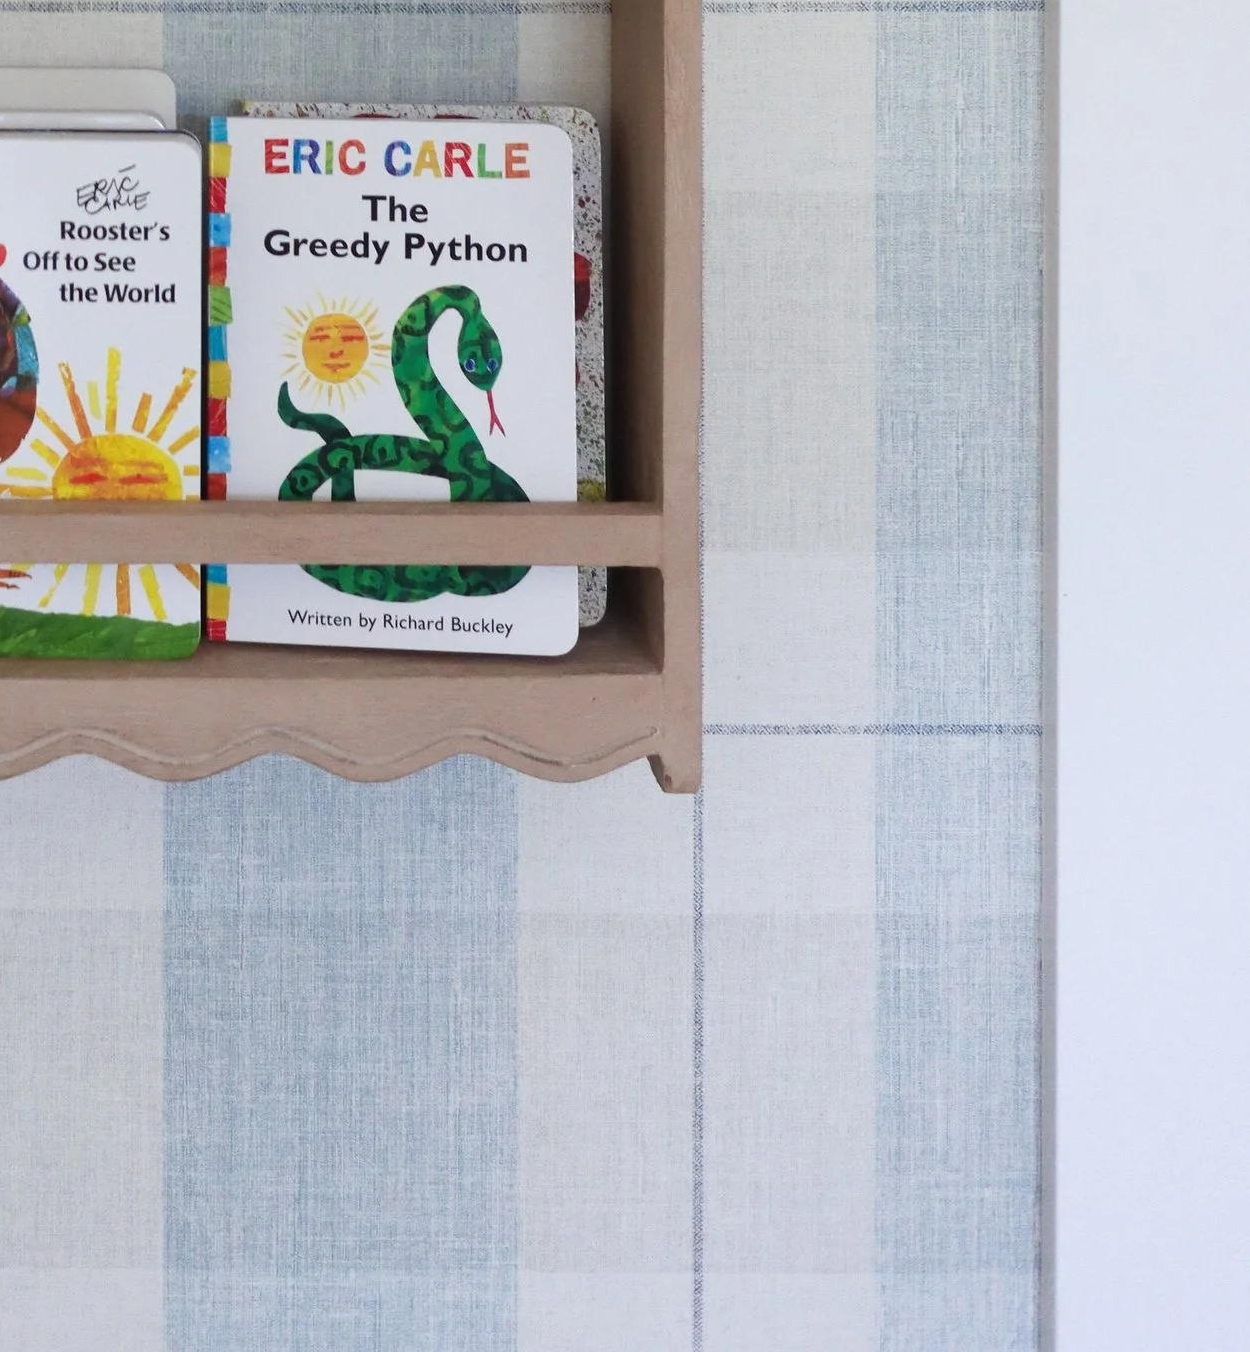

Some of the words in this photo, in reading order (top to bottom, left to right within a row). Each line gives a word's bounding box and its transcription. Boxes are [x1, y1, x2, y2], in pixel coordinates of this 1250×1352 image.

[264, 138, 367, 176] ERIC
[383, 140, 531, 179] CARLE
[361, 194, 429, 223] The
[59, 220, 171, 241] Rooster's
[22, 250, 60, 271] Off
[64, 252, 89, 272] to
[93, 251, 136, 272] See
[264, 229, 390, 265] Greedy
[404, 232, 528, 266] Python
[59, 282, 98, 303] the
[103, 283, 176, 304] World
[288, 608, 352, 627] Written
[359, 612, 377, 633] by
[383, 613, 444, 632] Richard
[451, 616, 514, 639] Buckley
